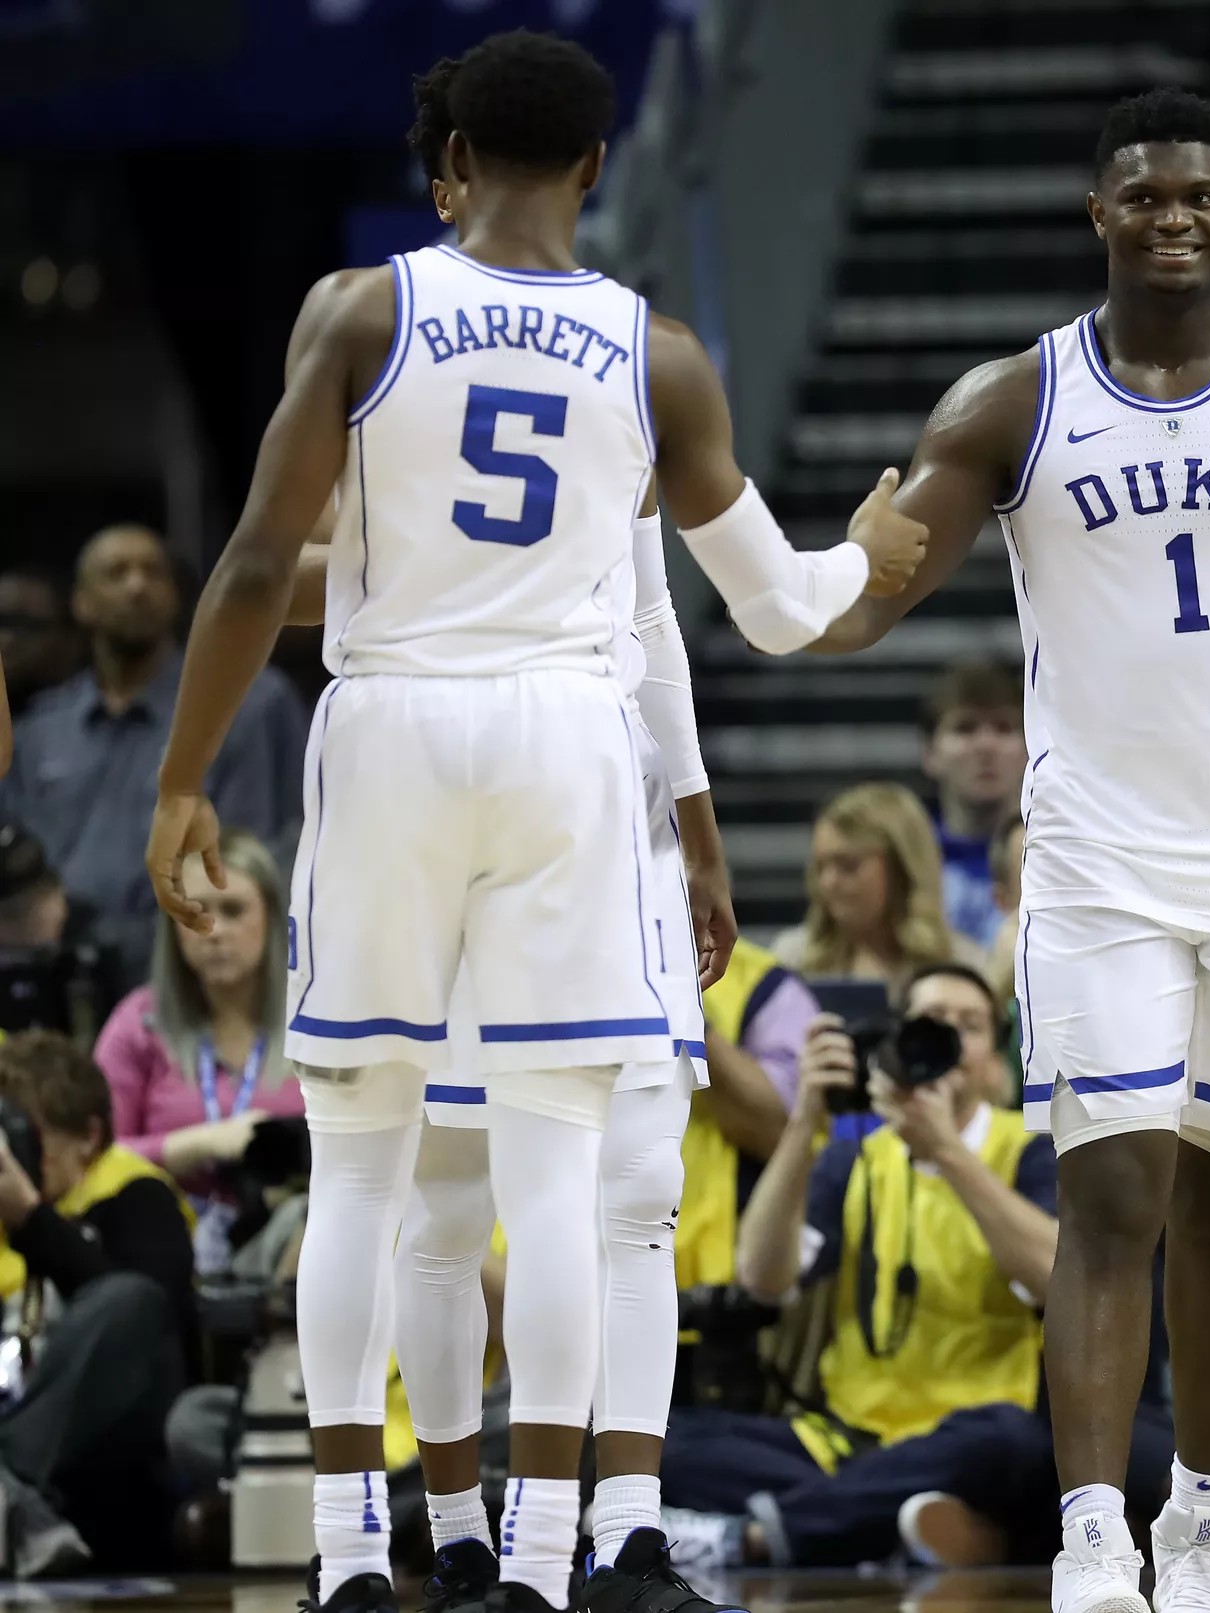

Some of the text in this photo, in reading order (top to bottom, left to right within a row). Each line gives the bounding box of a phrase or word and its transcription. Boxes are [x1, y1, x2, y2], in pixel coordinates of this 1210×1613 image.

[417, 305, 629, 383] BARRETT
[452, 384, 569, 547] 5
[1165, 533, 1210, 634] 1
